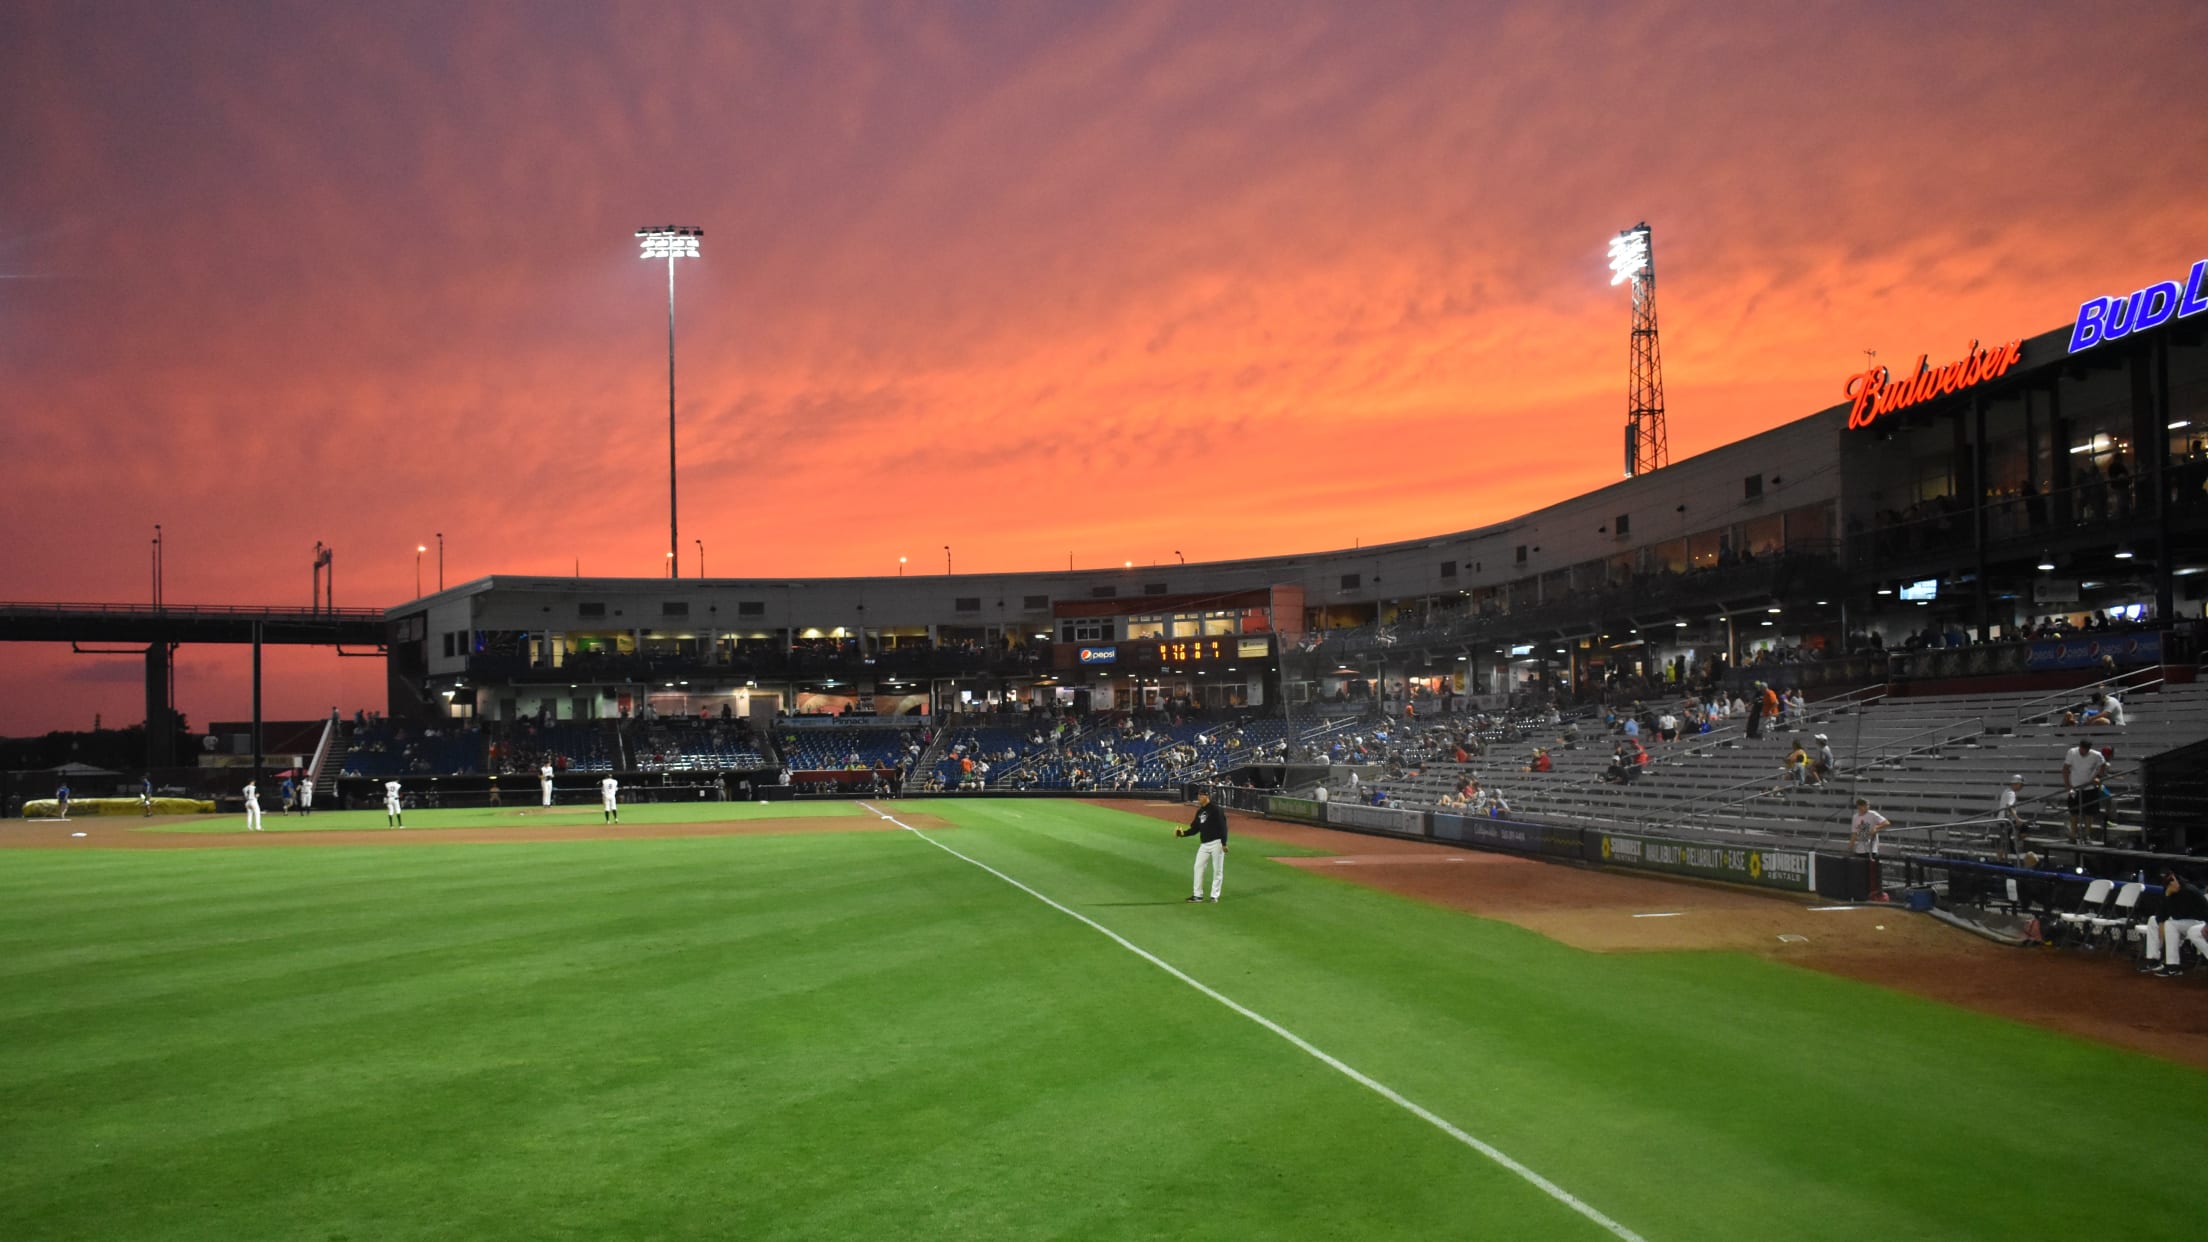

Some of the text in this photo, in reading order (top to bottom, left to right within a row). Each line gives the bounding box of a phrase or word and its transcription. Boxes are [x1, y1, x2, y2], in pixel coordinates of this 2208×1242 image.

[2068, 280, 2184, 354] BUD
[1843, 338, 2023, 430] Budweiser
[1092, 649, 1116, 659] pepsi
[1610, 837, 1642, 856] SUNBELT
[1645, 843, 1745, 870] AVAILABILITY RELIABILITY EASE
[1761, 852, 1807, 874] SUNBELT
[1768, 871, 1801, 882] RENTALS
